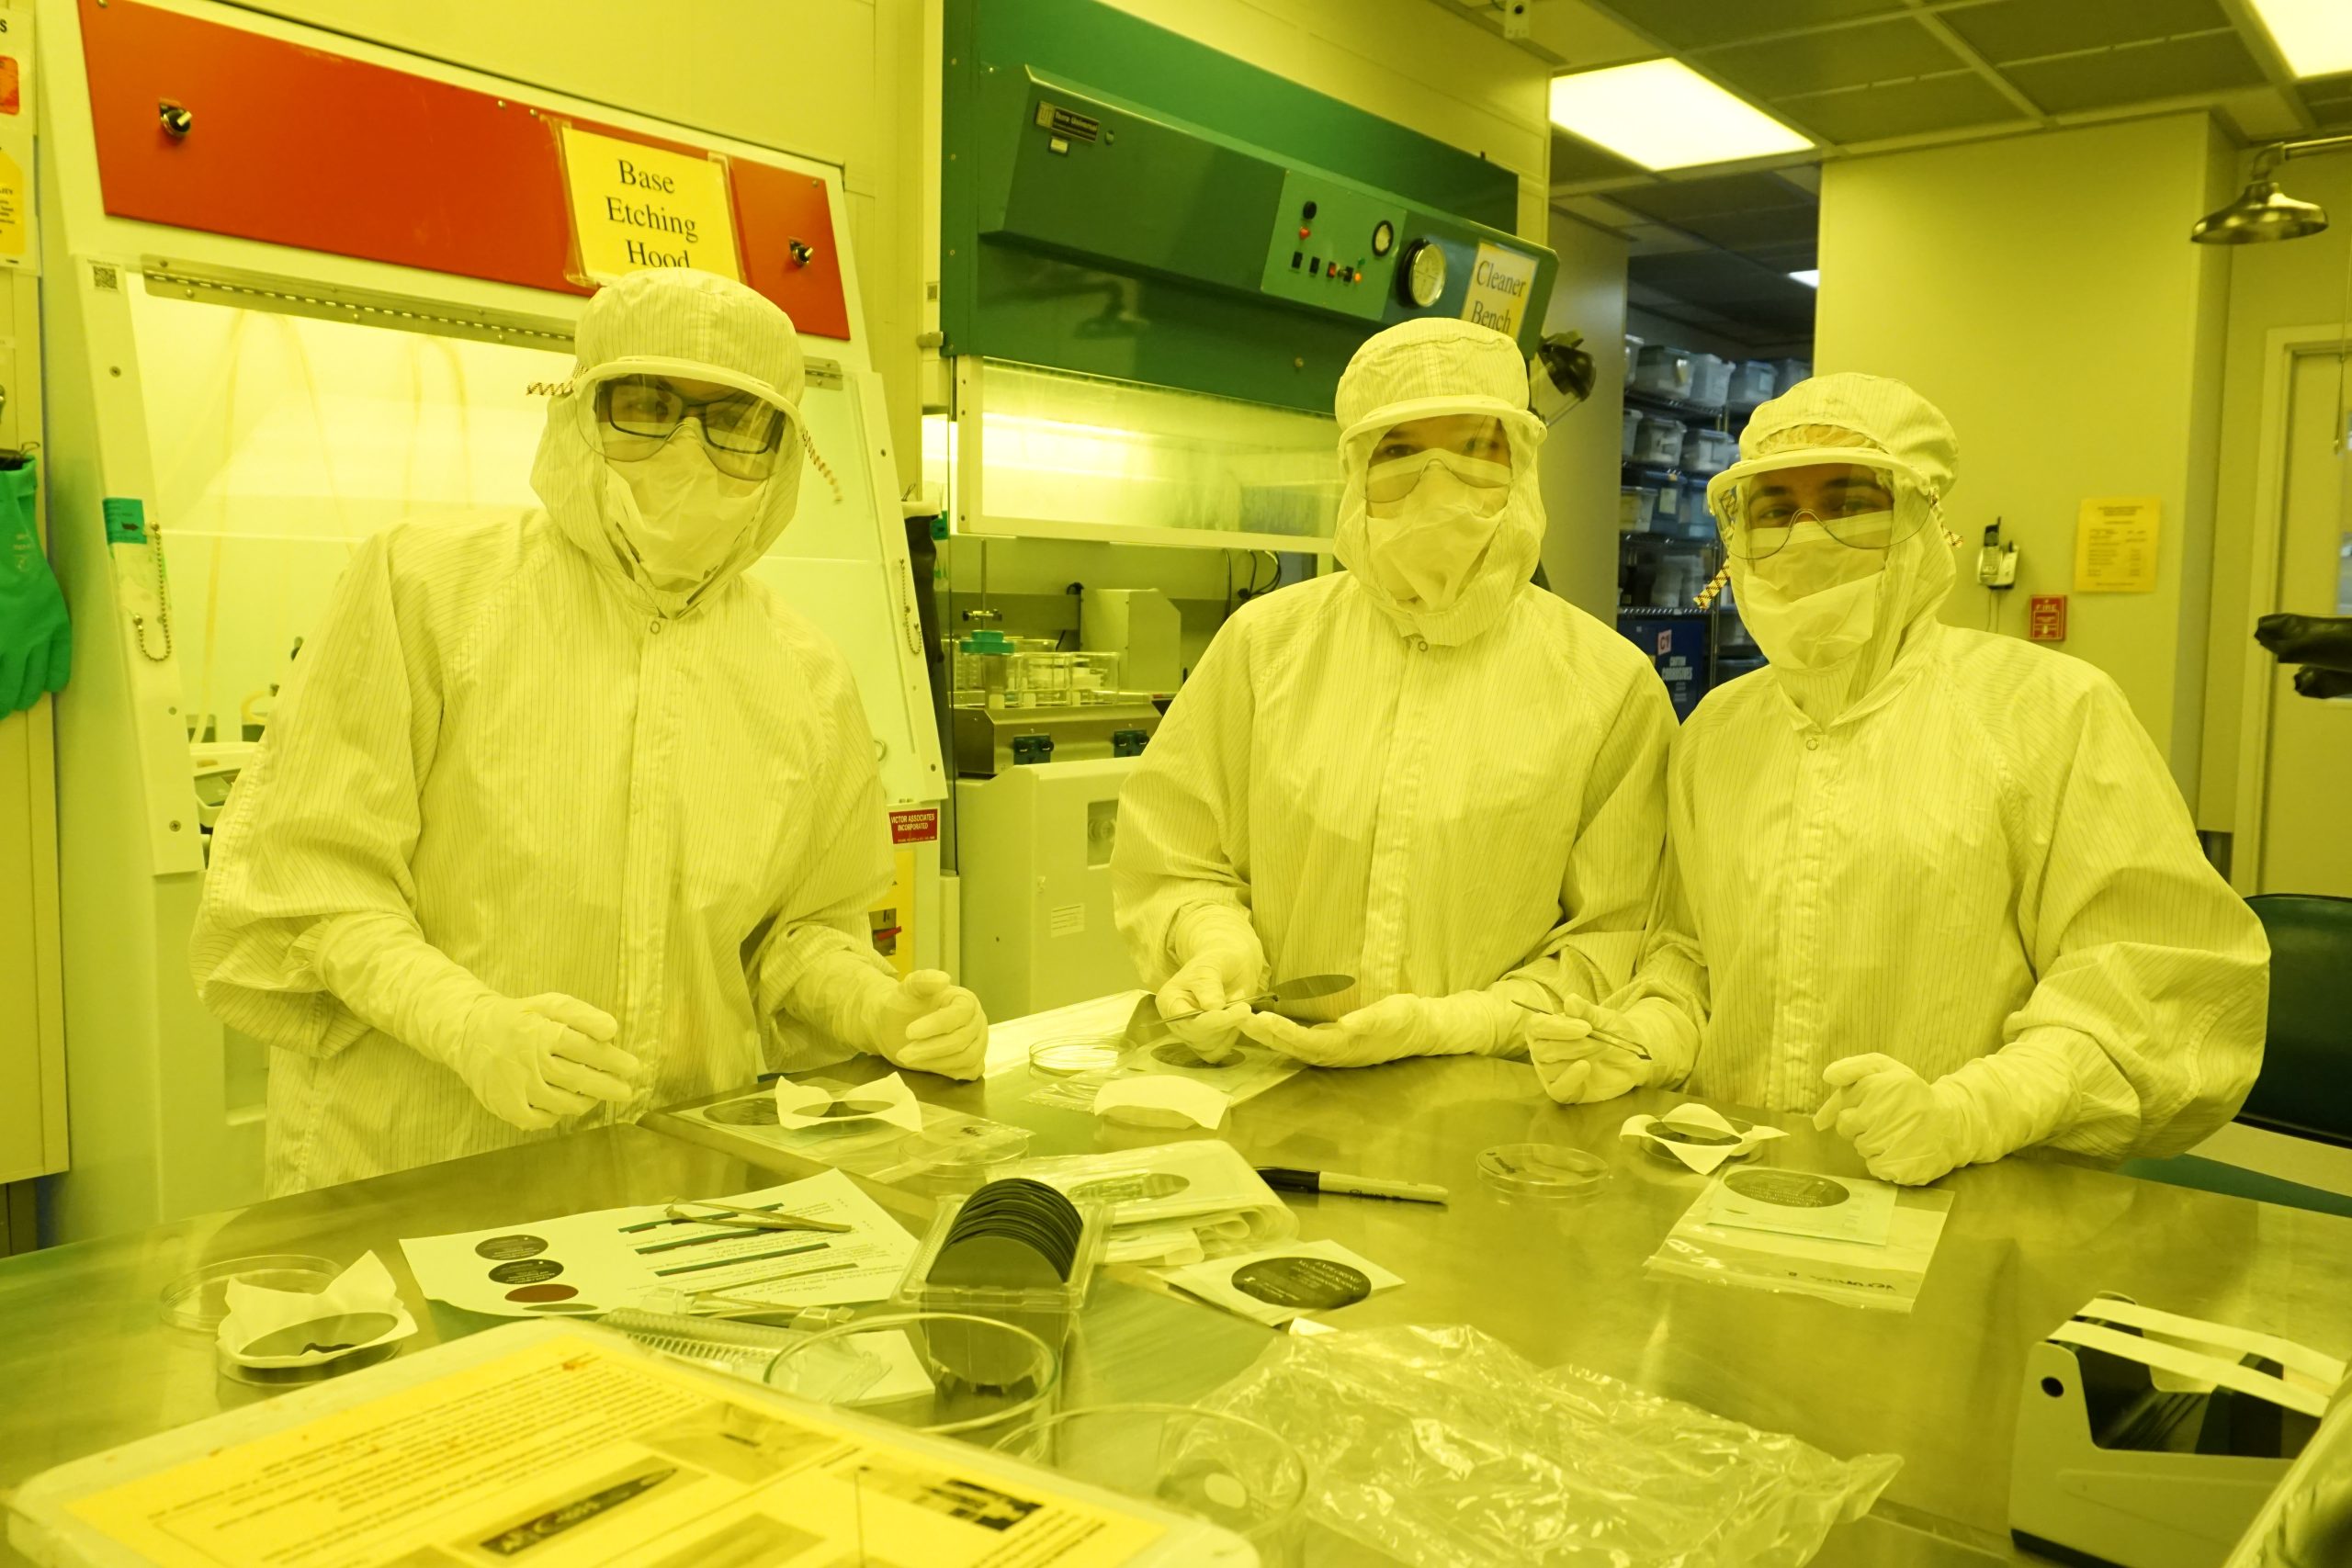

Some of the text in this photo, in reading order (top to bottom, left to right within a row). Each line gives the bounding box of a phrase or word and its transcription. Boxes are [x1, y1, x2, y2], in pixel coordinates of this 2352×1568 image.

[617, 160, 675, 194] Base
[605, 196, 698, 243] Etching
[626, 239, 690, 268] Hood
[1476, 260, 1527, 298] Cleaner
[1471, 300, 1511, 333] Bench
[909, 814, 935, 822] ASSOCIATES
